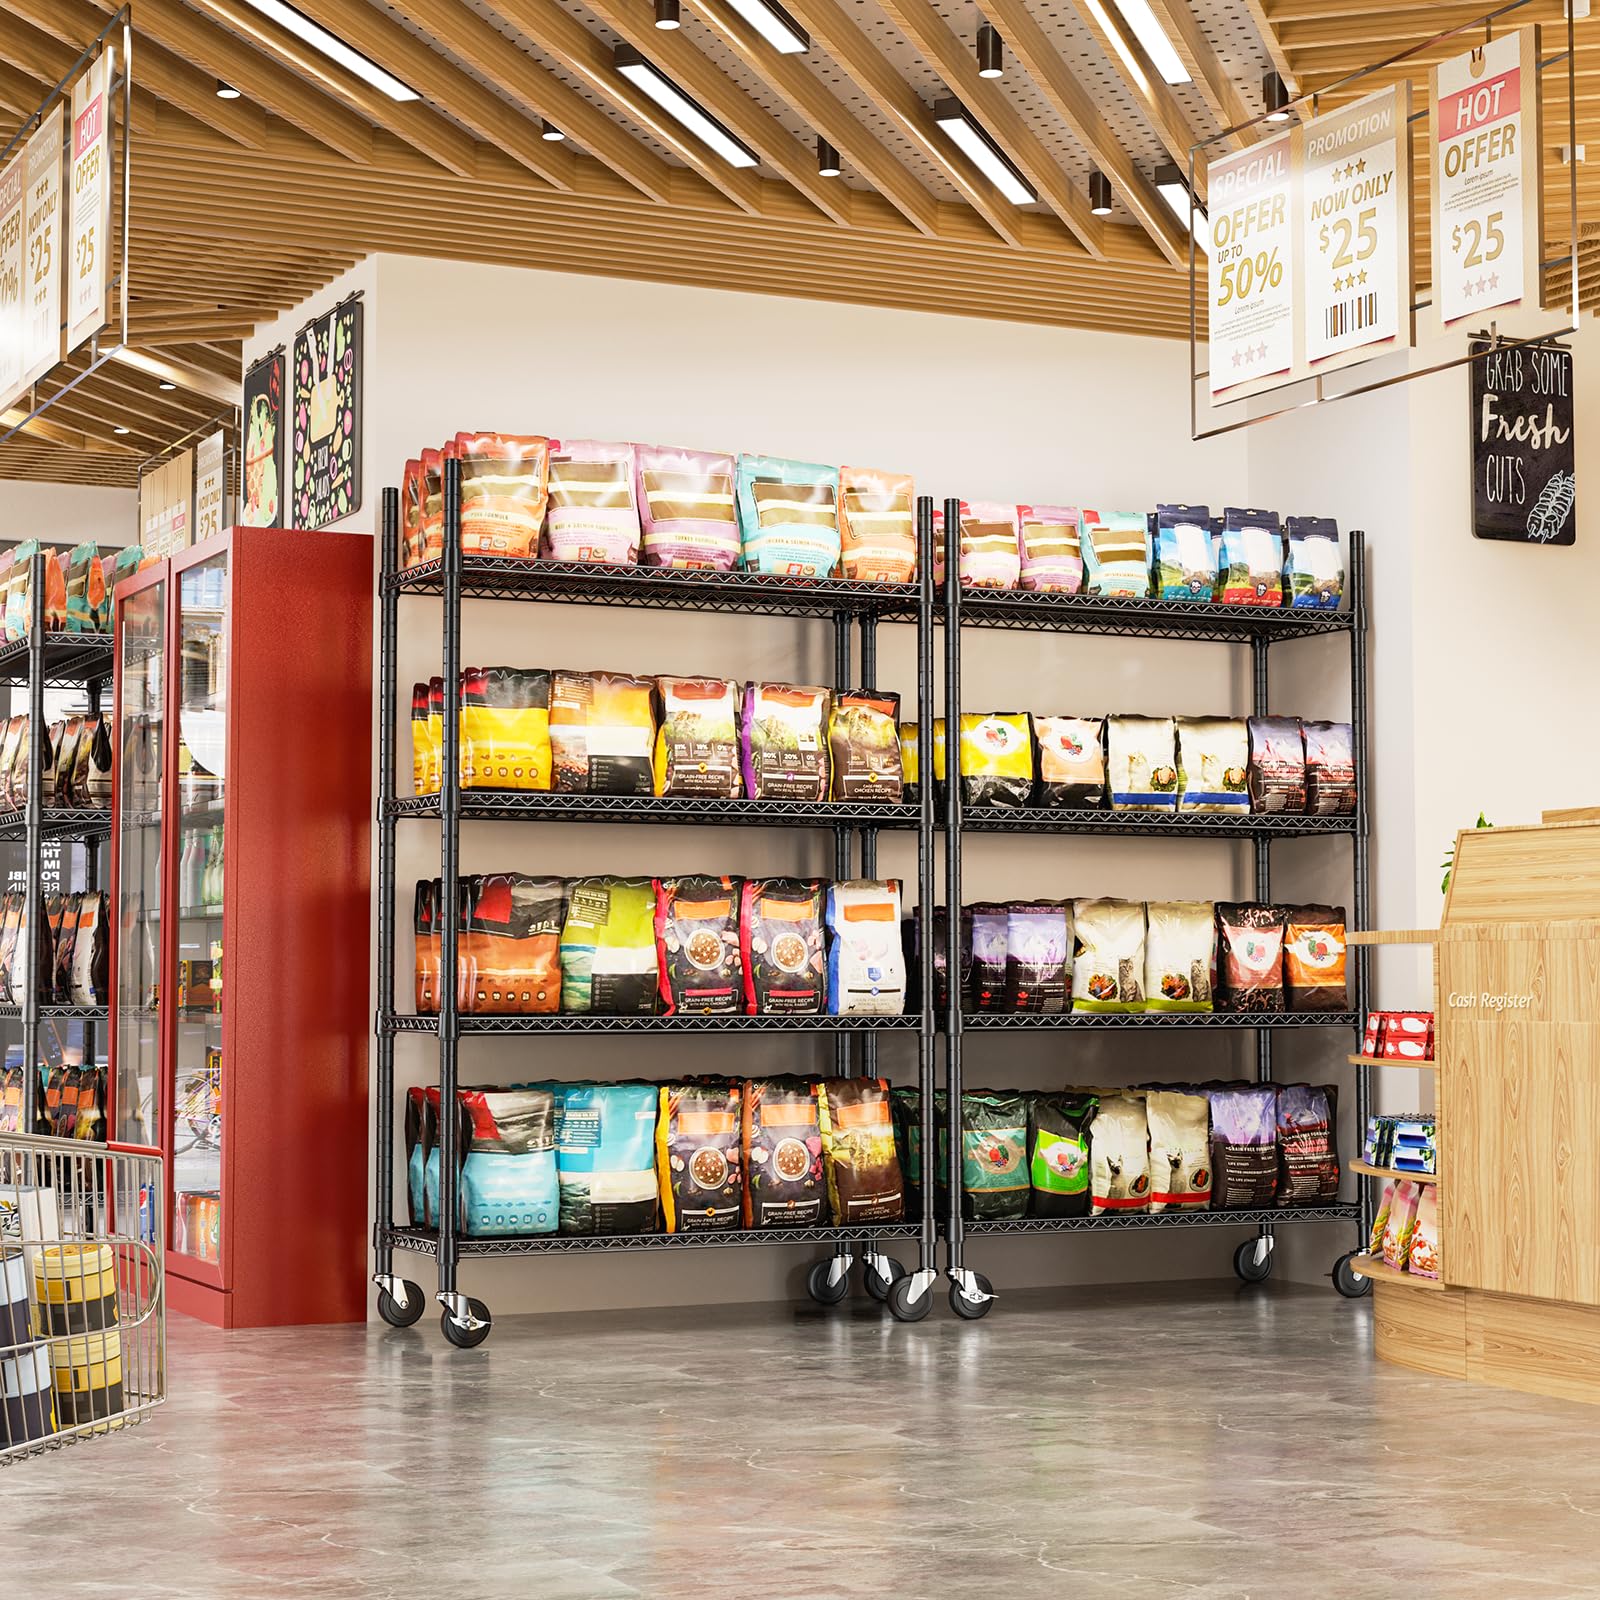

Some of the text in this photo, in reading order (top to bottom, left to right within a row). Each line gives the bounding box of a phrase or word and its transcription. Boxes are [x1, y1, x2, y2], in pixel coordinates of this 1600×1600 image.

[80, 104, 98, 151] HOT
[1456, 80, 1506, 131] HOT
[1308, 108, 1391, 160] PROMOTION
[1444, 123, 1516, 178] OFFER
[75, 144, 100, 195] OFFER
[1214, 151, 1286, 201] SPECIAL
[28, 189, 58, 237] NOW ONLY
[1214, 193, 1286, 248] OFFER
[1311, 170, 1393, 222] NOW ONLY
[31, 224, 51, 285] $25
[76, 226, 95, 279] $25
[1218, 244, 1243, 264] UP TO
[1320, 207, 1378, 269] $25
[1452, 211, 1504, 269] $25
[1217, 246, 1283, 306] 50%
[1486, 350, 1569, 397] GRAB SOME
[1481, 393, 1570, 450] Fresh
[1486, 454, 1525, 504] CUTS
[1448, 991, 1533, 1012] Cash Register
